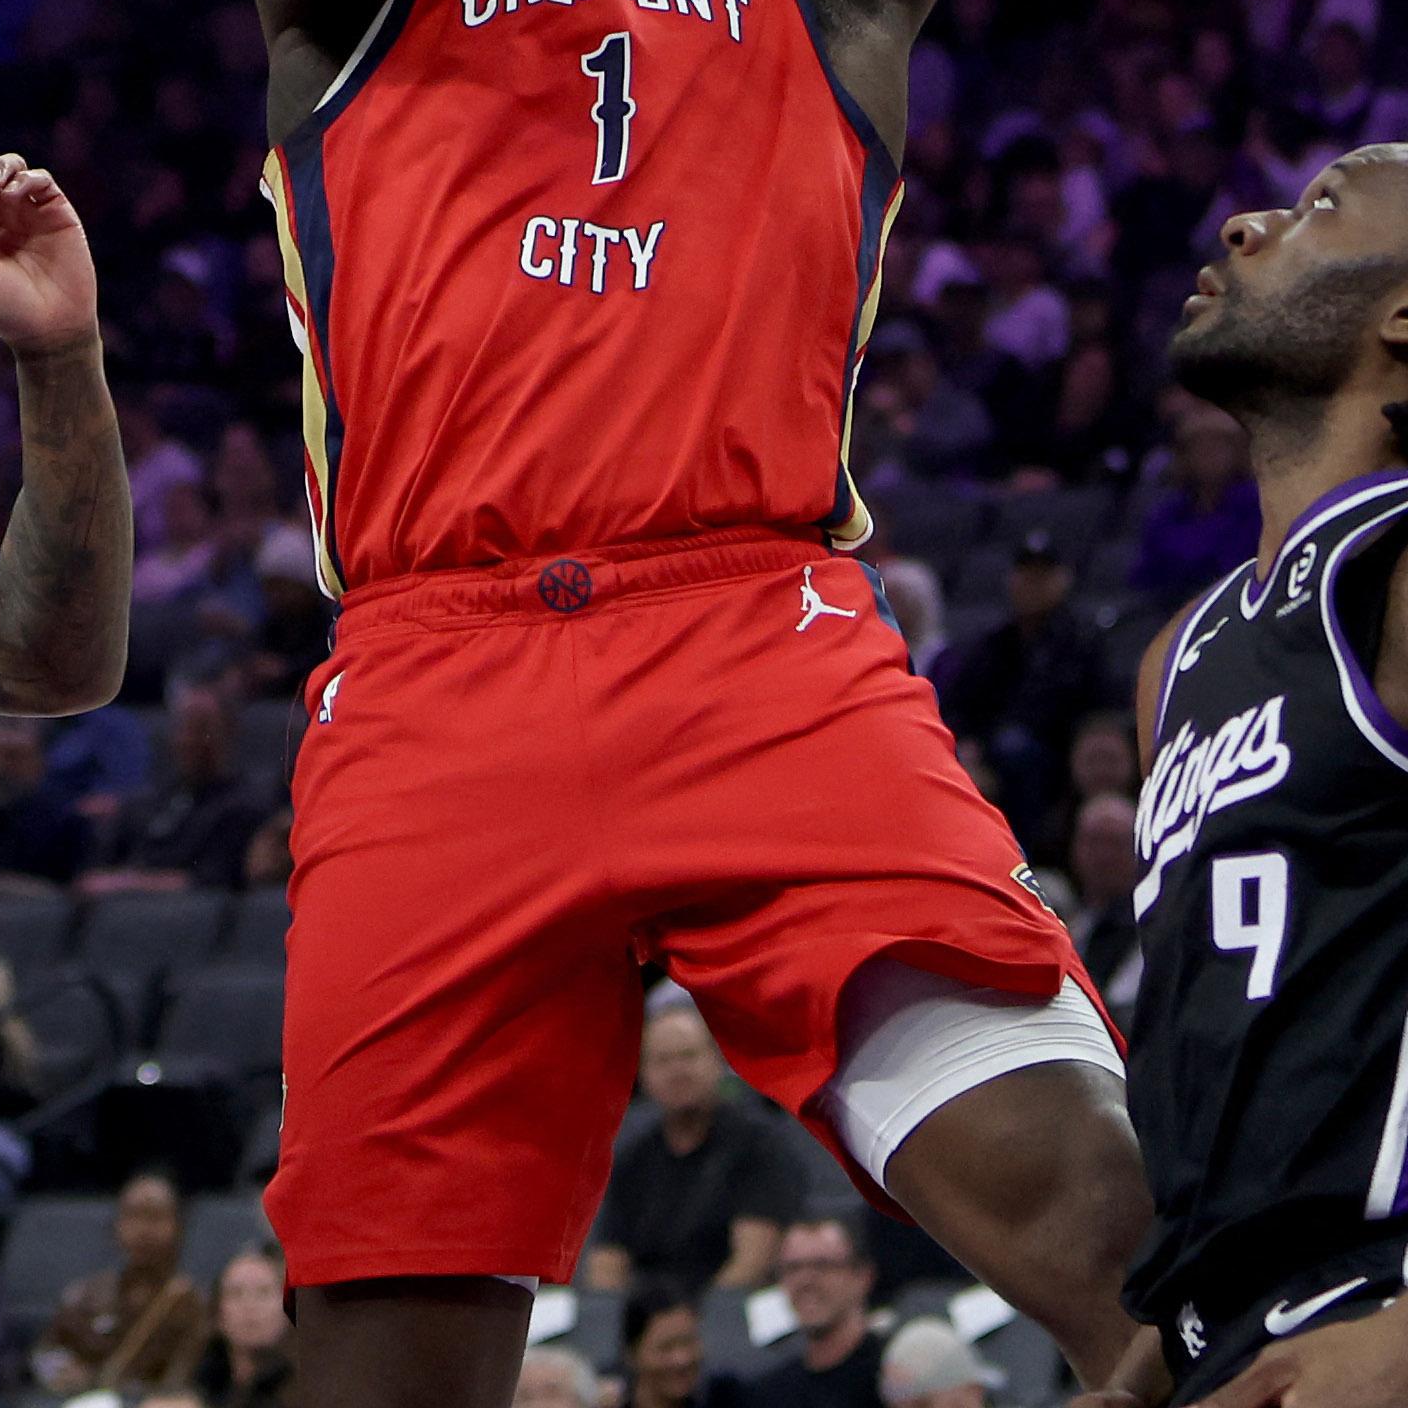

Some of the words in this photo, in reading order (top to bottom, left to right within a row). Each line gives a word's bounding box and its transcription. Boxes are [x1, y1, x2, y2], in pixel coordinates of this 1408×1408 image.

[579, 30, 637, 187] 1
[519, 215, 666, 295] CITY
[1210, 850, 1291, 1003] 9
